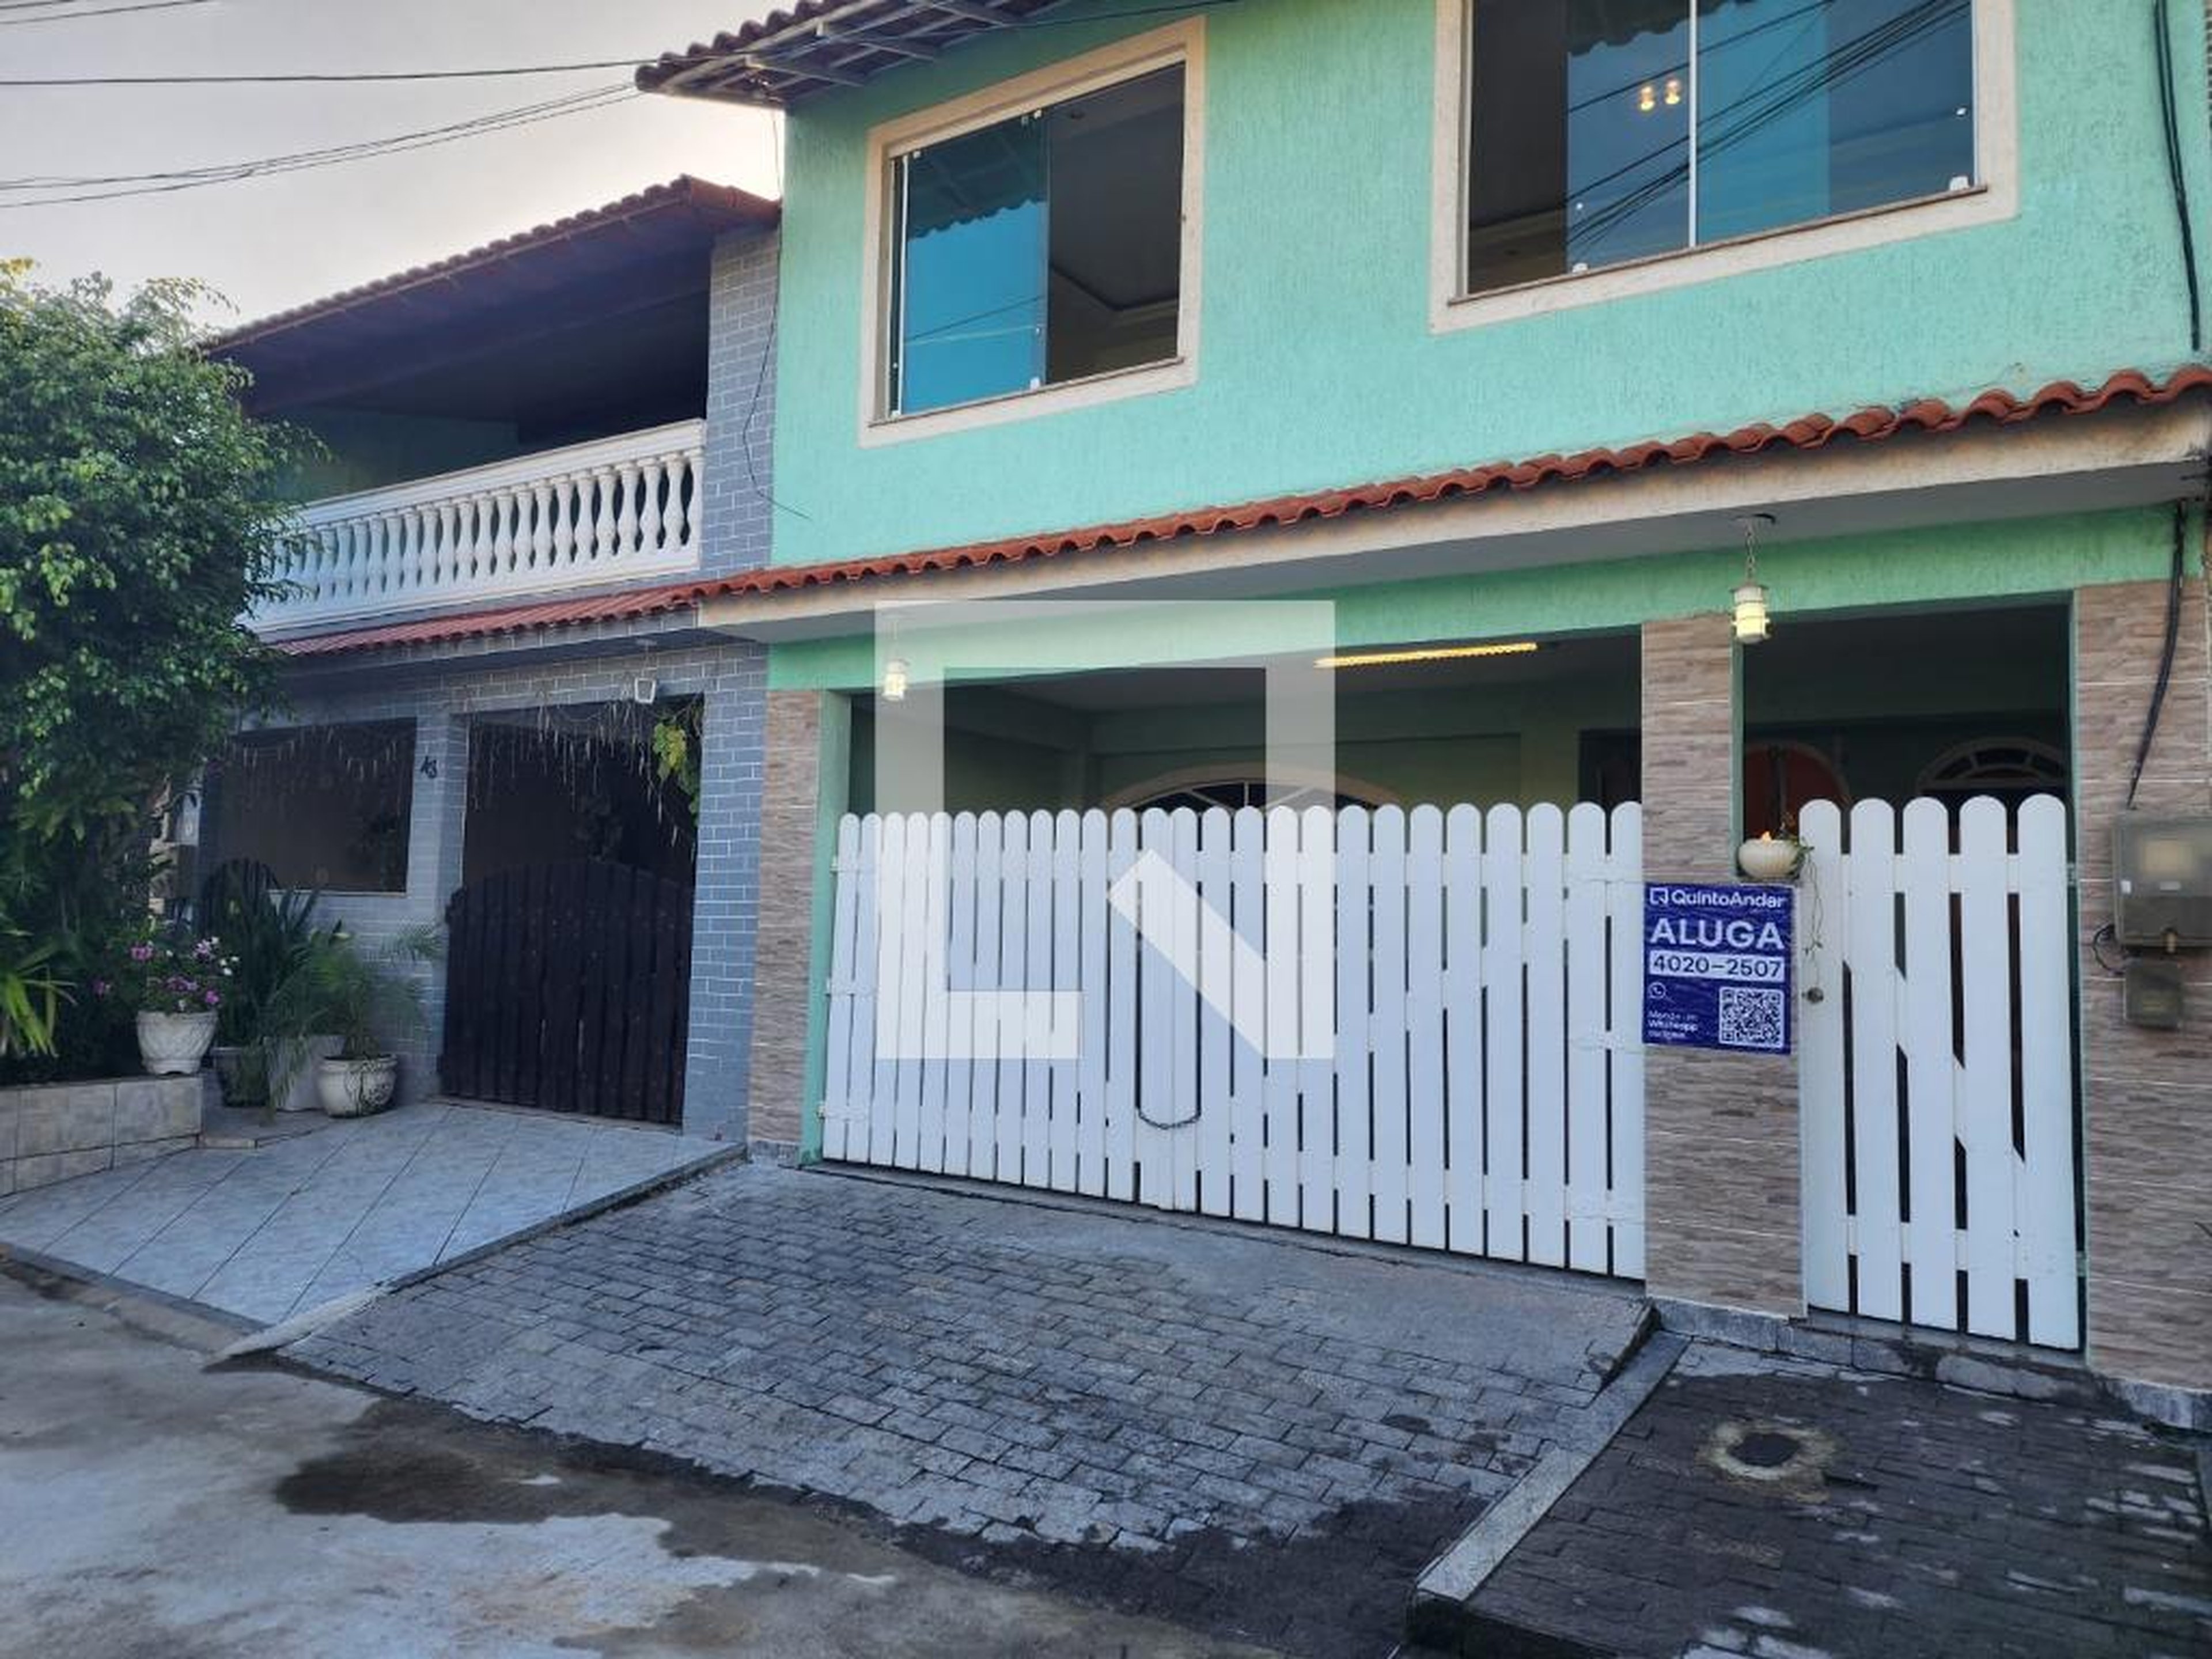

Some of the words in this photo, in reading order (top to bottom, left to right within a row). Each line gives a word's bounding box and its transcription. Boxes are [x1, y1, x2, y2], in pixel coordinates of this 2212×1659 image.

[1671, 889, 1786, 908] QuintoAndar
[1650, 918, 1785, 949] ALUGA
[1653, 955, 1781, 977] 4020-2507
